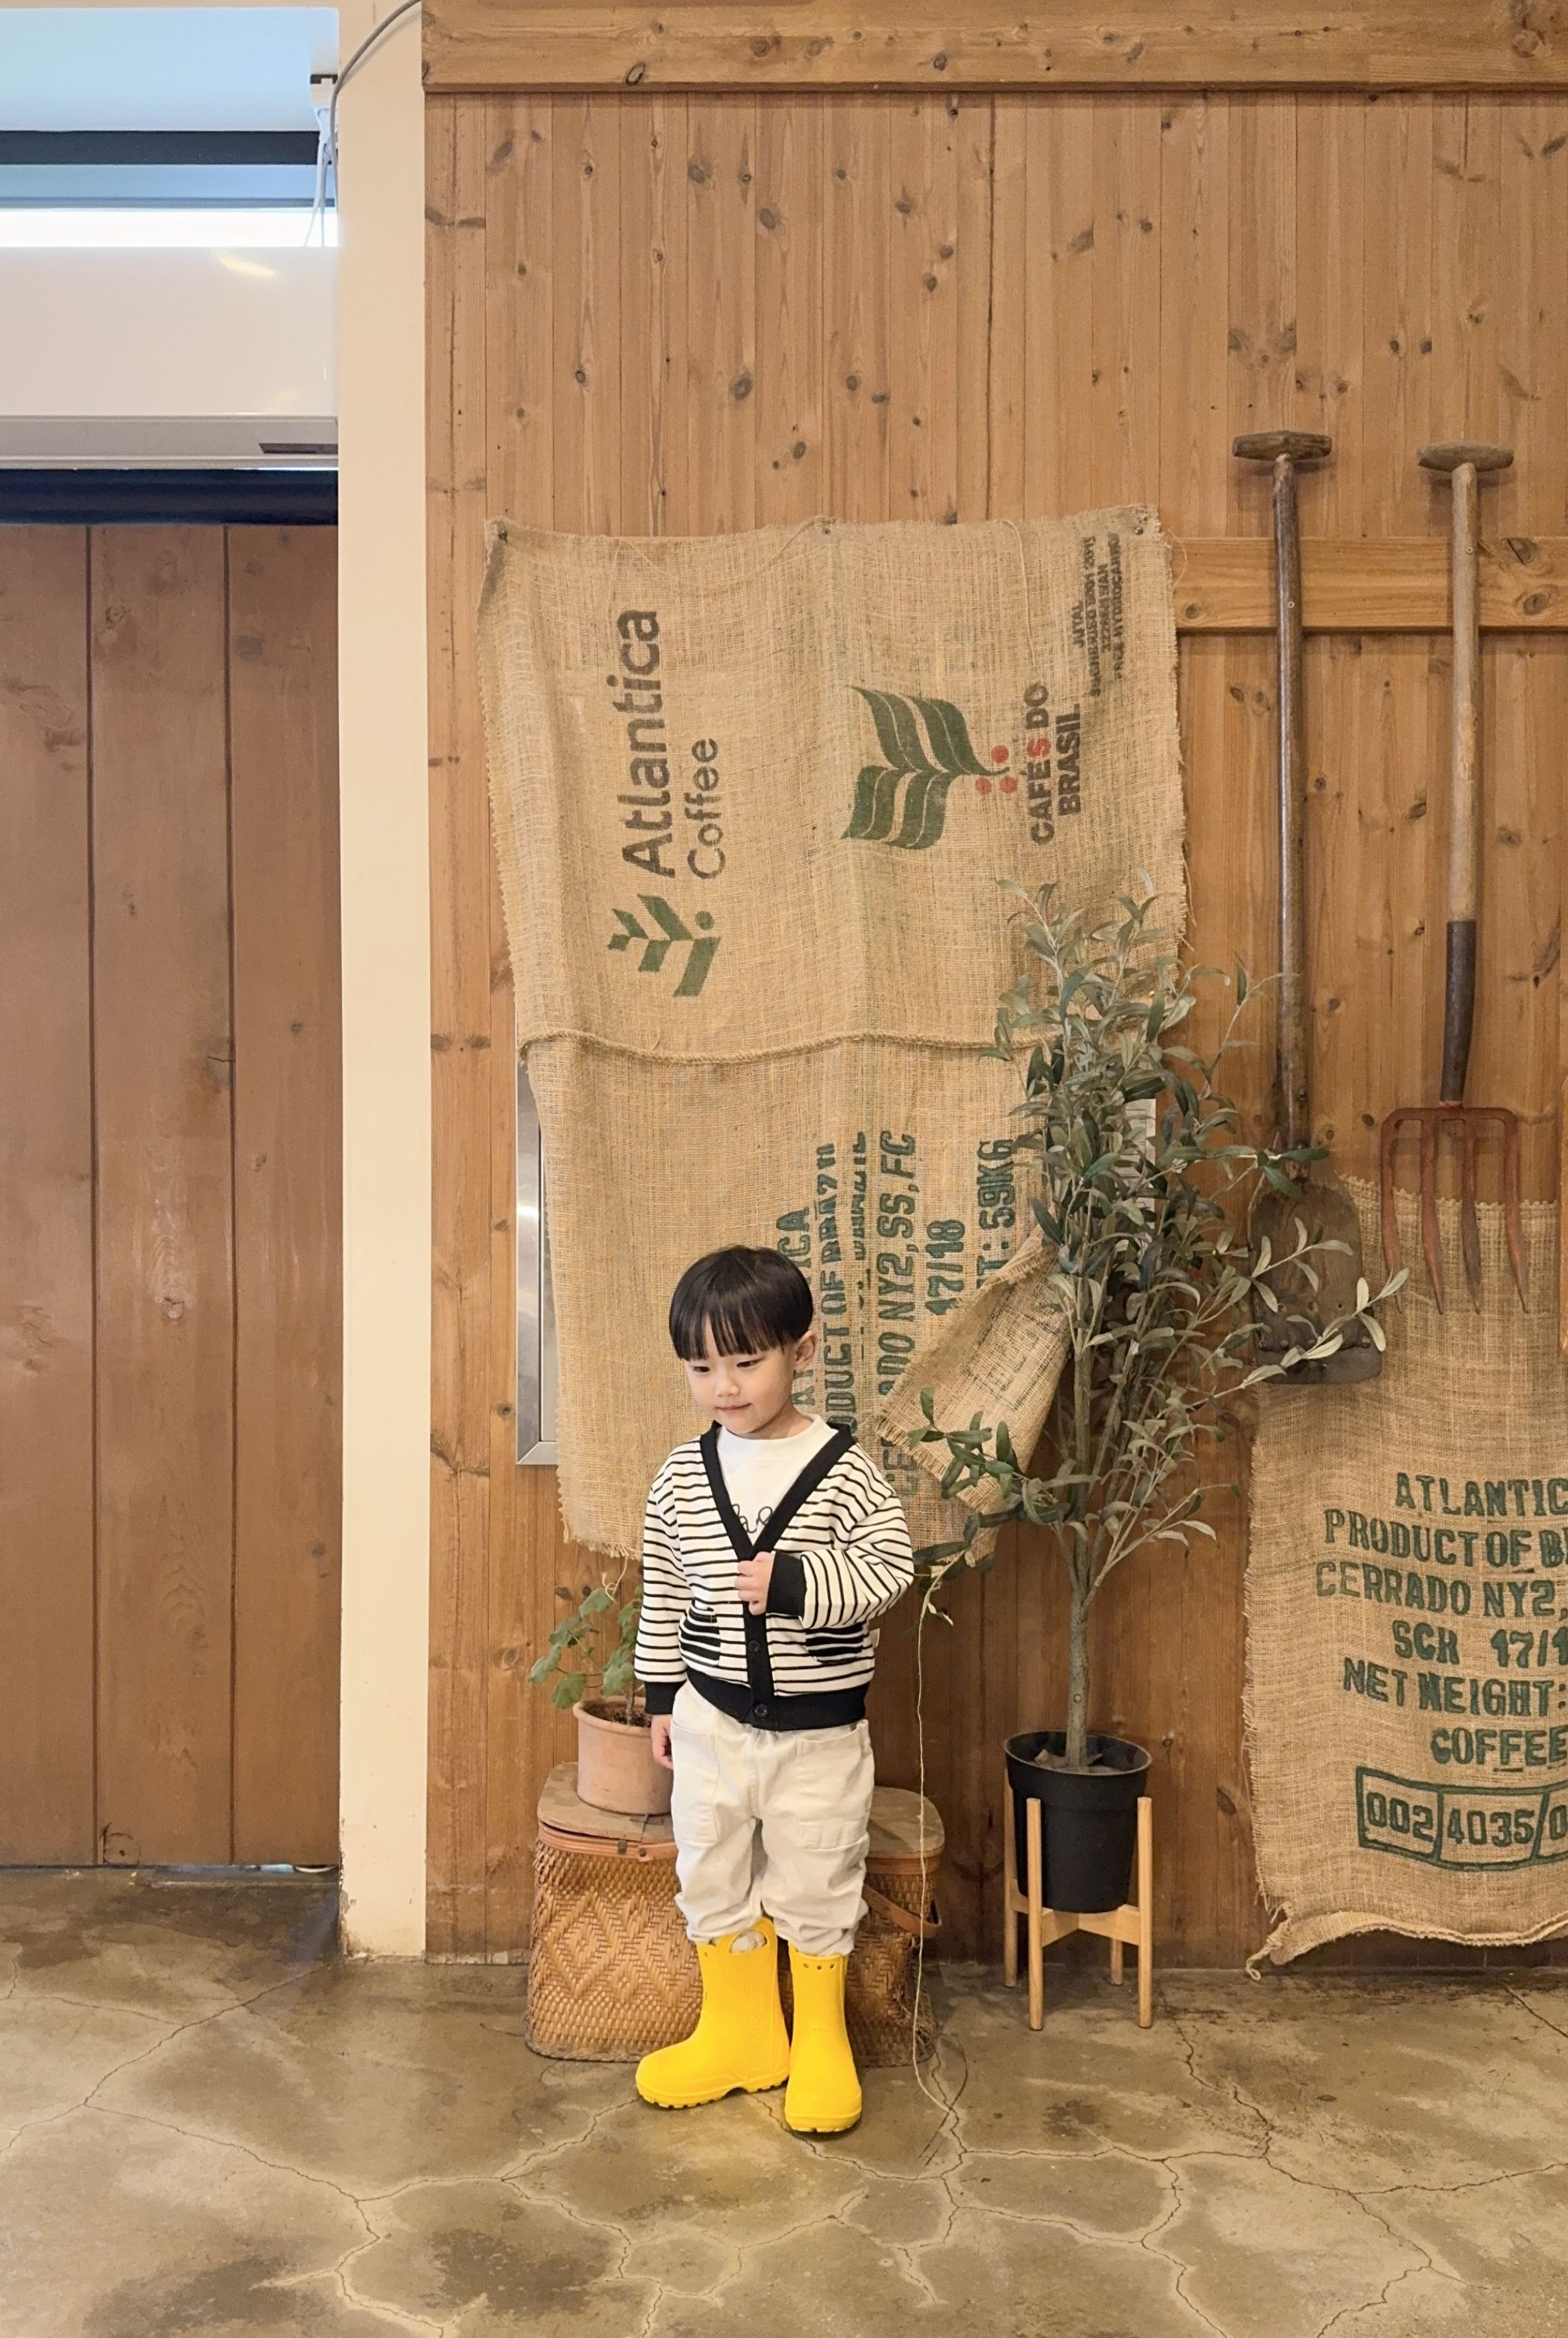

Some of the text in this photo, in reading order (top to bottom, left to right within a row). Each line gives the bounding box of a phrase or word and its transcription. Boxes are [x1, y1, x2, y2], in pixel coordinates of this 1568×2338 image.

[1024, 682, 1049, 728] DO
[606, 609, 676, 879] Atlantica
[1055, 704, 1081, 816] BRASIL
[684, 737, 726, 880] Coffee
[820, 1270, 848, 1316] OF
[924, 1219, 966, 1316] 17/18
[1324, 1509, 1480, 1567] PRODUCT
[1485, 1528, 1532, 1568] OF
[1315, 1561, 1471, 1616] CERRADO
[1392, 1619, 1460, 1665] SCR
[1343, 1657, 1409, 1704] NET
[1430, 1725, 1568, 1767] COFFEE
[1365, 1791, 1436, 1843] 002
[1447, 1808, 1535, 1848] 4035
